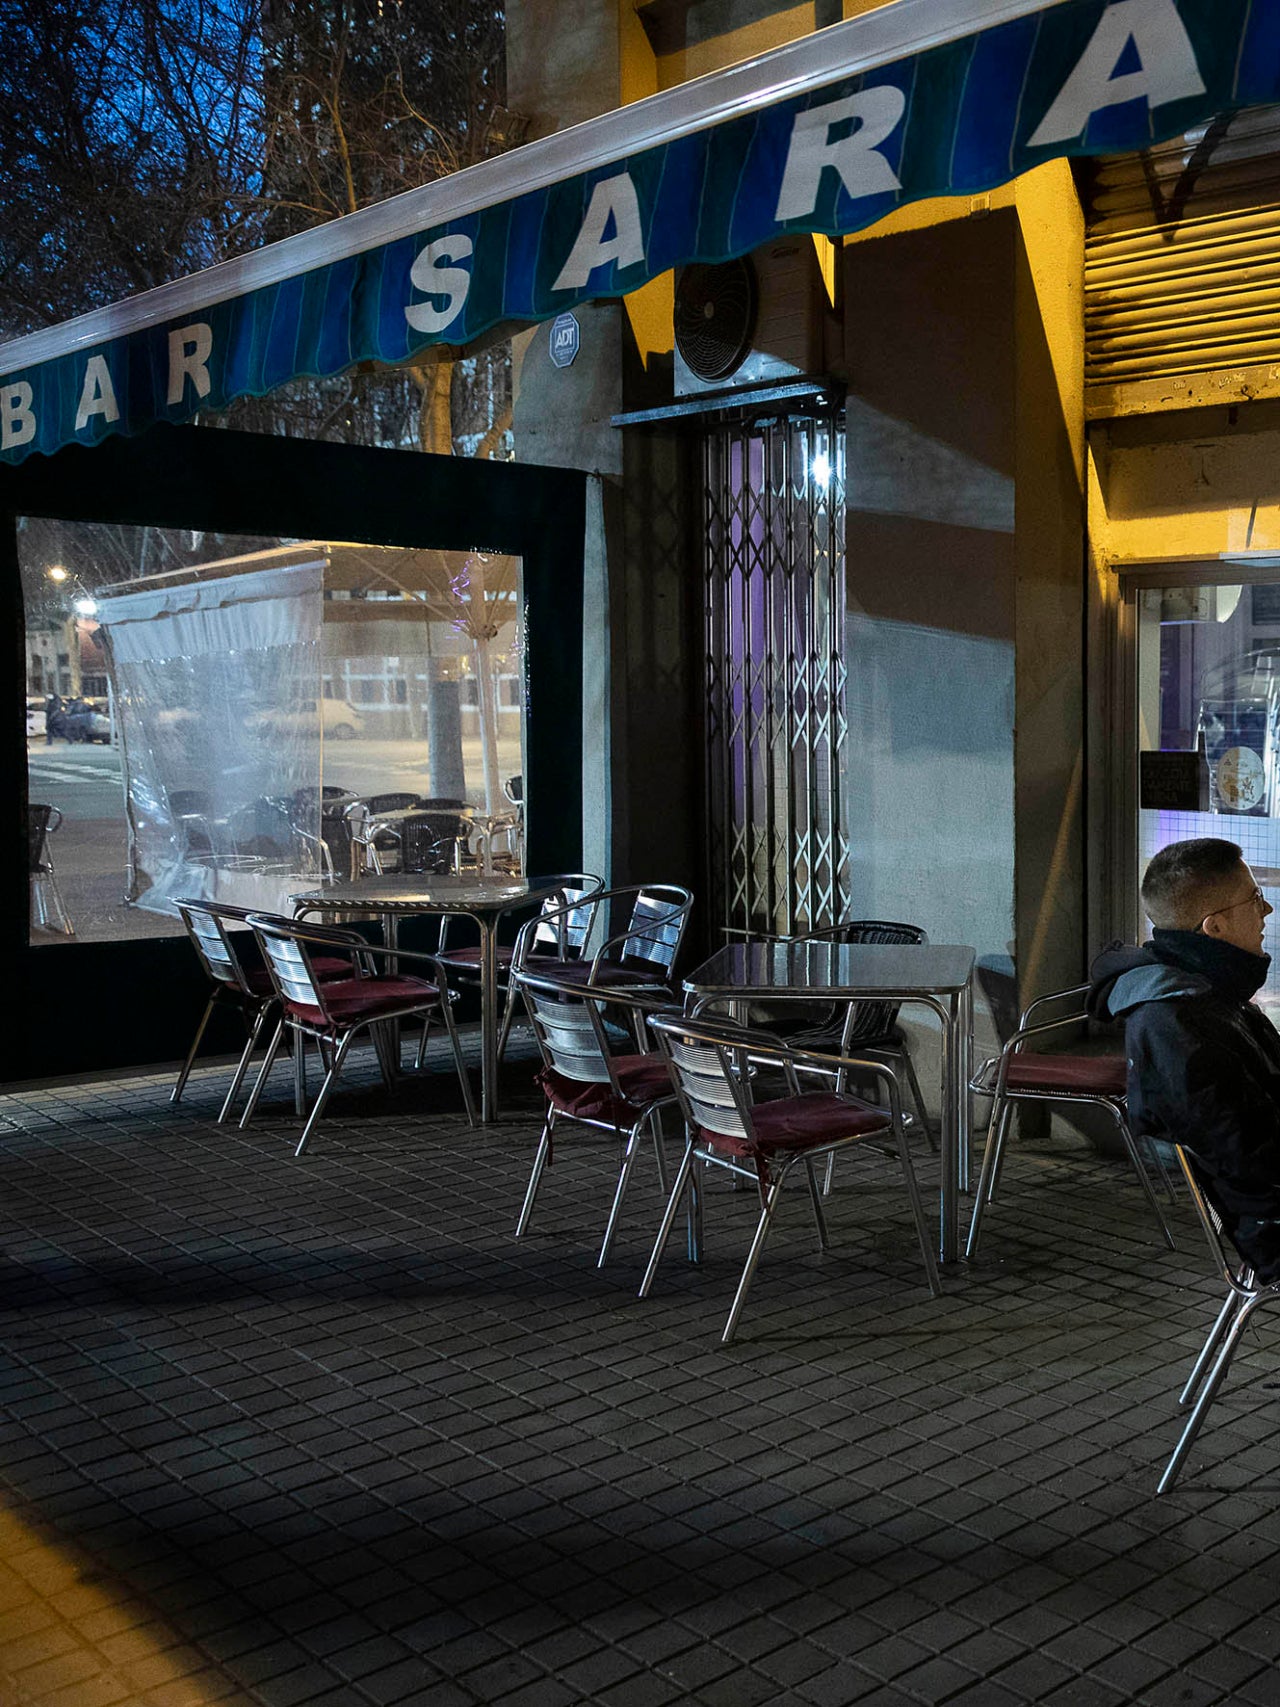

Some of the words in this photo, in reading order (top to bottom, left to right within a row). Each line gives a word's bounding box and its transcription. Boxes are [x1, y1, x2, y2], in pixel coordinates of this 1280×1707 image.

[0, 322, 213, 450] BAR
[405, 0, 1207, 333] SARA
[555, 328, 574, 348] ADT
